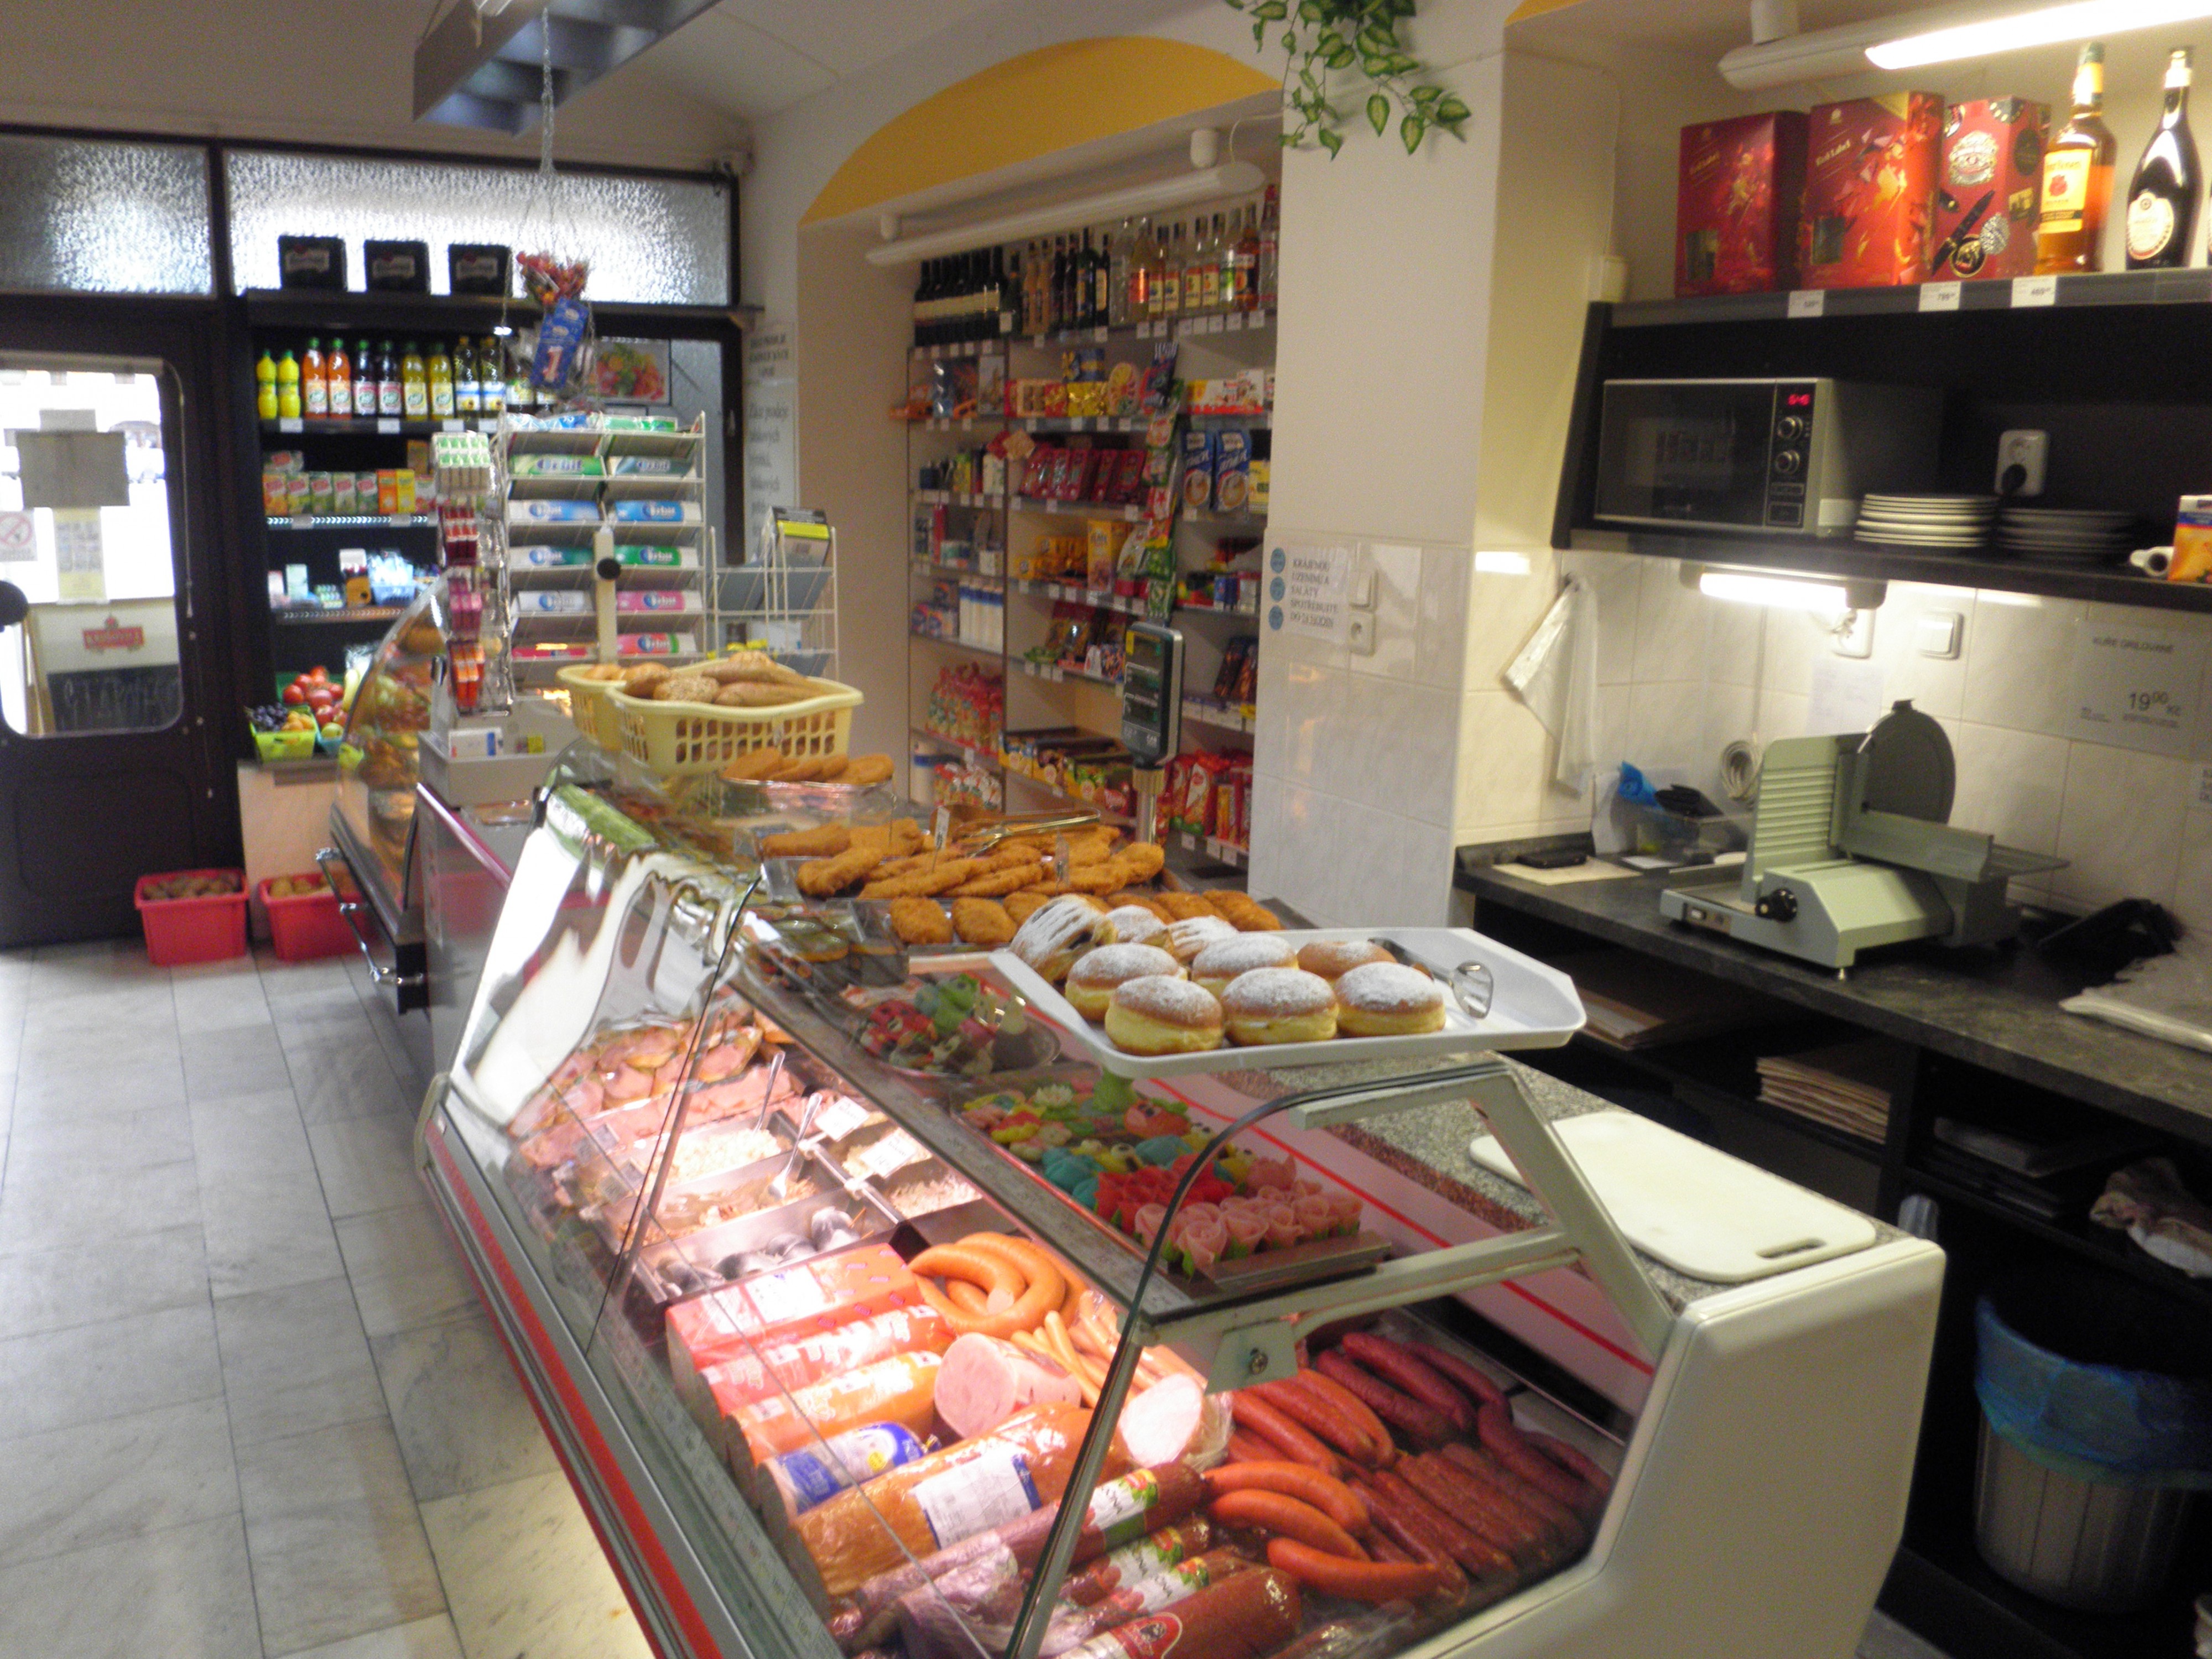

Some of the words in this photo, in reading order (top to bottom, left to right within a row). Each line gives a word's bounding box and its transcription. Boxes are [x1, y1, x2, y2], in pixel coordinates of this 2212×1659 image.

[537, 458, 582, 471] Orbit
[642, 502, 675, 518] Orbit
[639, 548, 673, 564] Orbit
[643, 591, 676, 609] Orbit
[637, 635, 670, 652] Orbit
